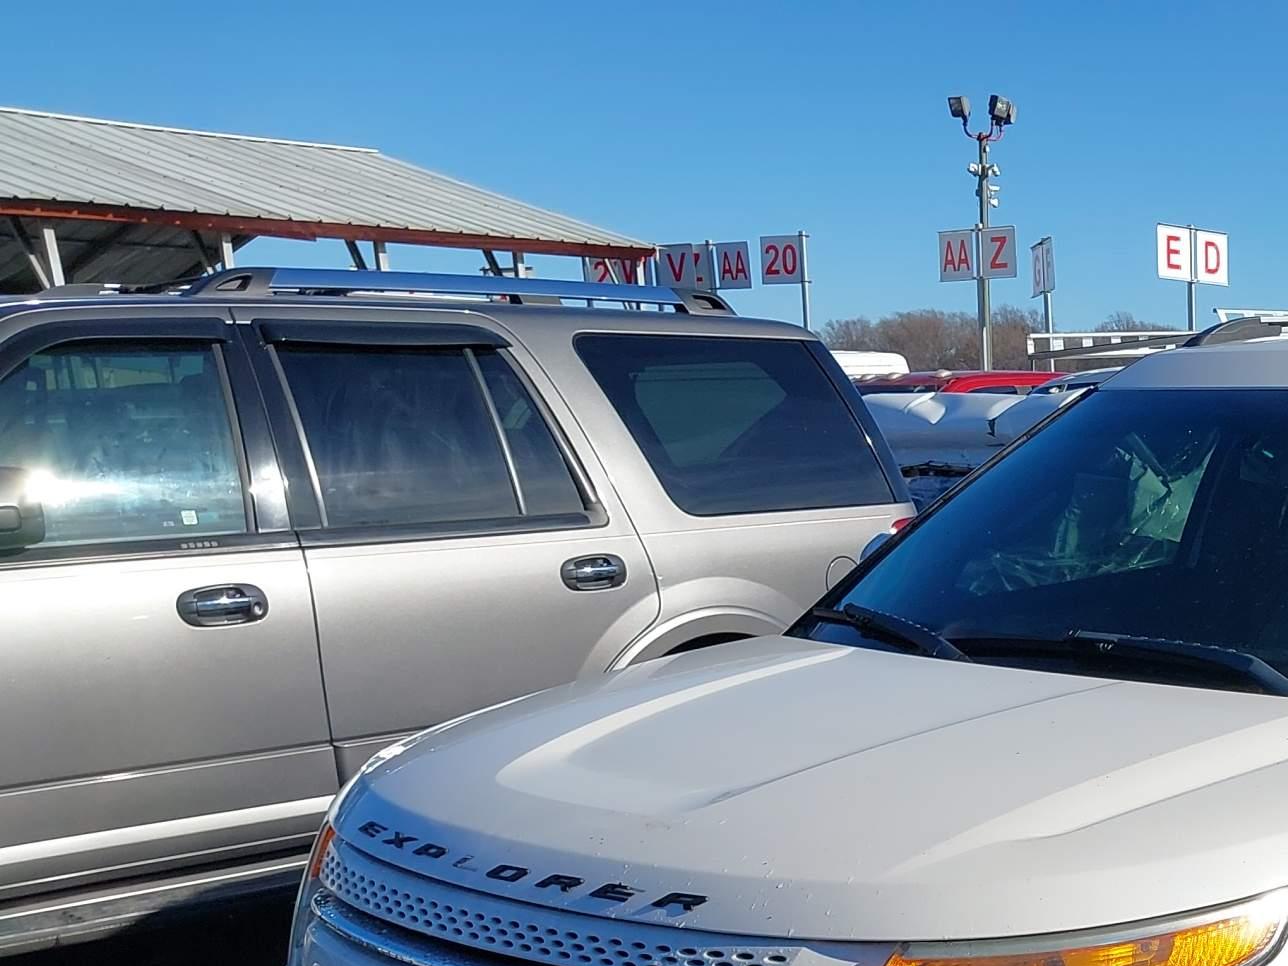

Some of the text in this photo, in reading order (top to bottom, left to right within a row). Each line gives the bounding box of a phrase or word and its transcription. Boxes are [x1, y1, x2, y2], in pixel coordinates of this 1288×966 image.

[667, 252, 686, 282] V
[722, 251, 747, 281] AA
[765, 244, 797, 275] 20
[943, 240, 970, 272] AA
[990, 236, 1008, 269] Z
[1166, 235, 1181, 269] E
[1205, 242, 1220, 274] D
[358, 820, 710, 911] EXPLORER
